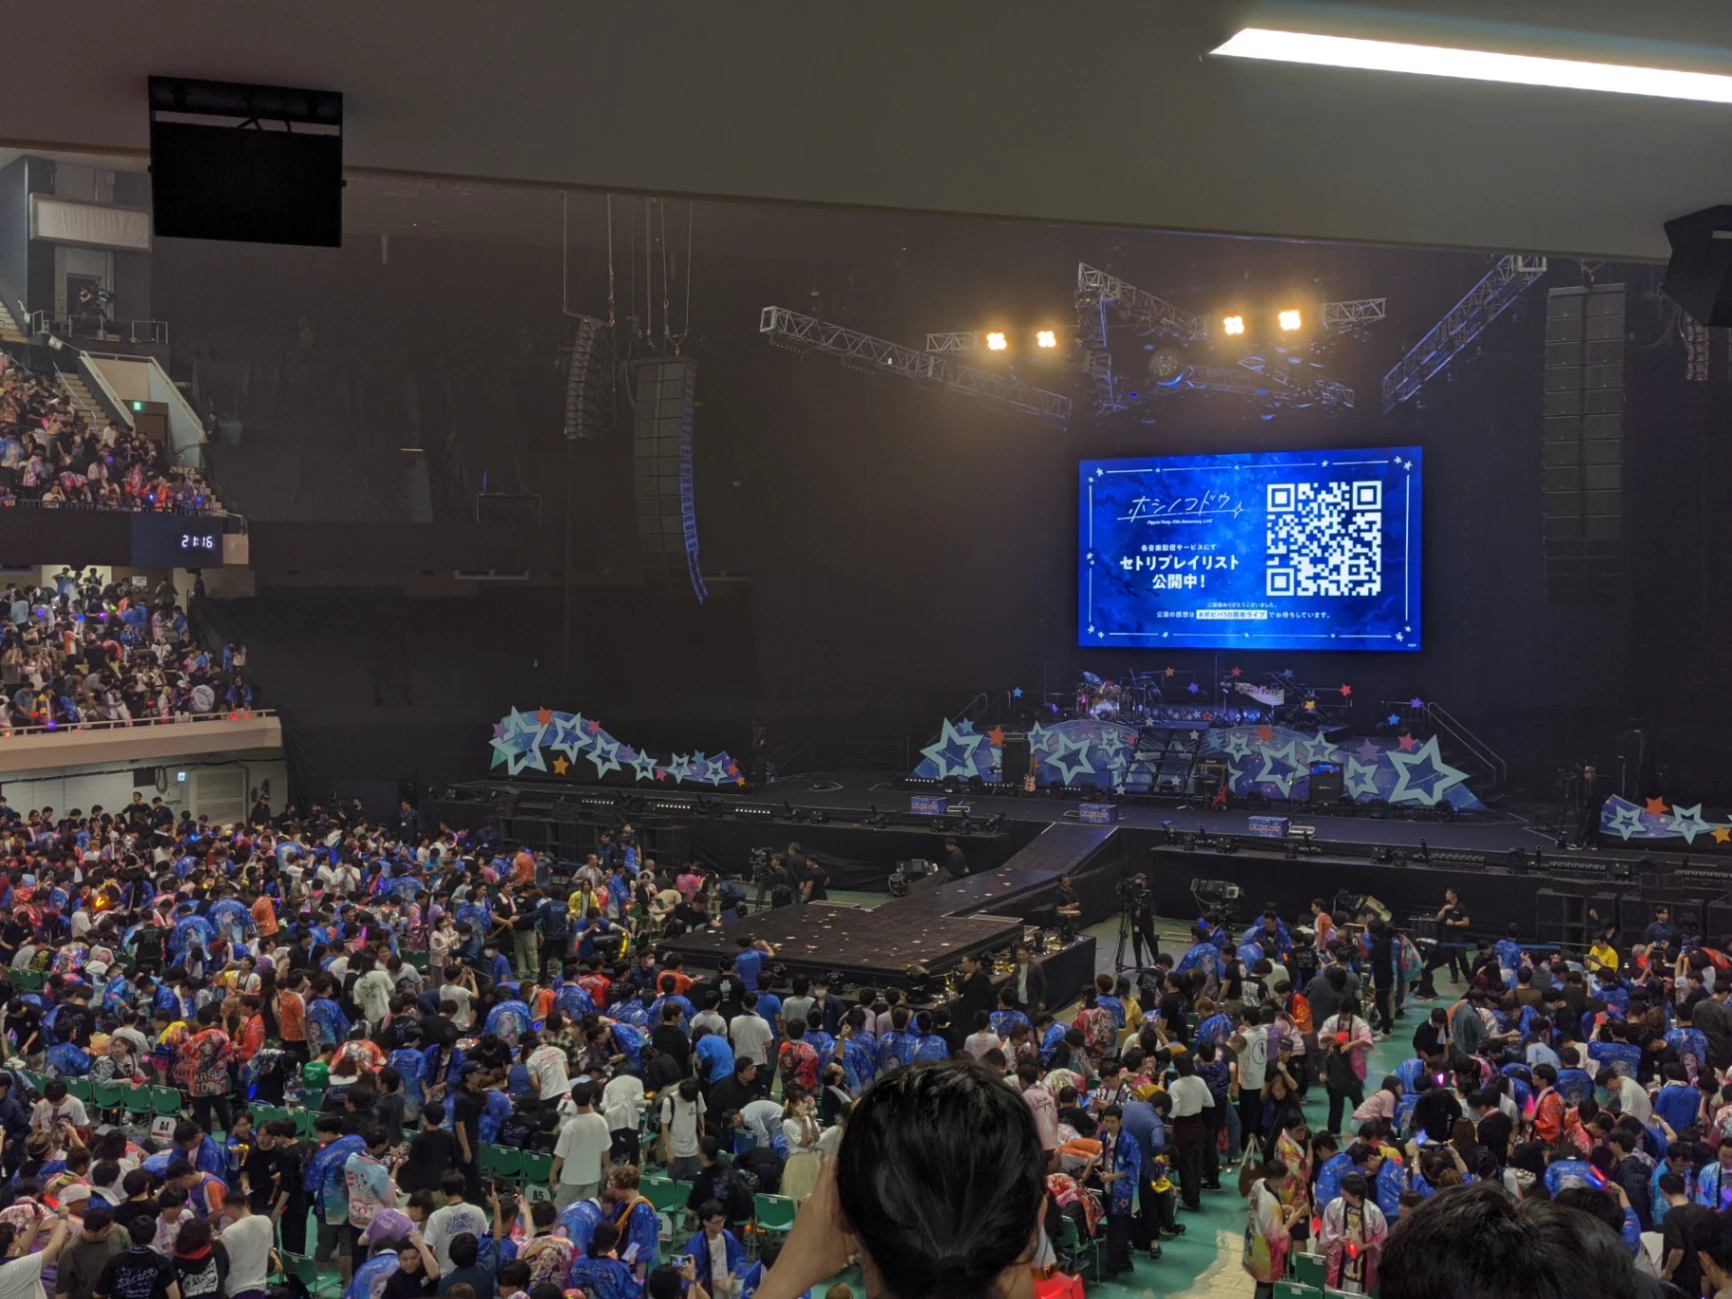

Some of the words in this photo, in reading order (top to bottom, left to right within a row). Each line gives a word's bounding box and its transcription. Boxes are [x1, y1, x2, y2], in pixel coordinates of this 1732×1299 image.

[181, 534, 213, 548] 21:16
[1120, 555, 1239, 571] セトリプレイリスト
[1152, 574, 1206, 589] 公開中!
[158, 1121, 169, 1132] A4
[532, 1190, 544, 1201] A5
